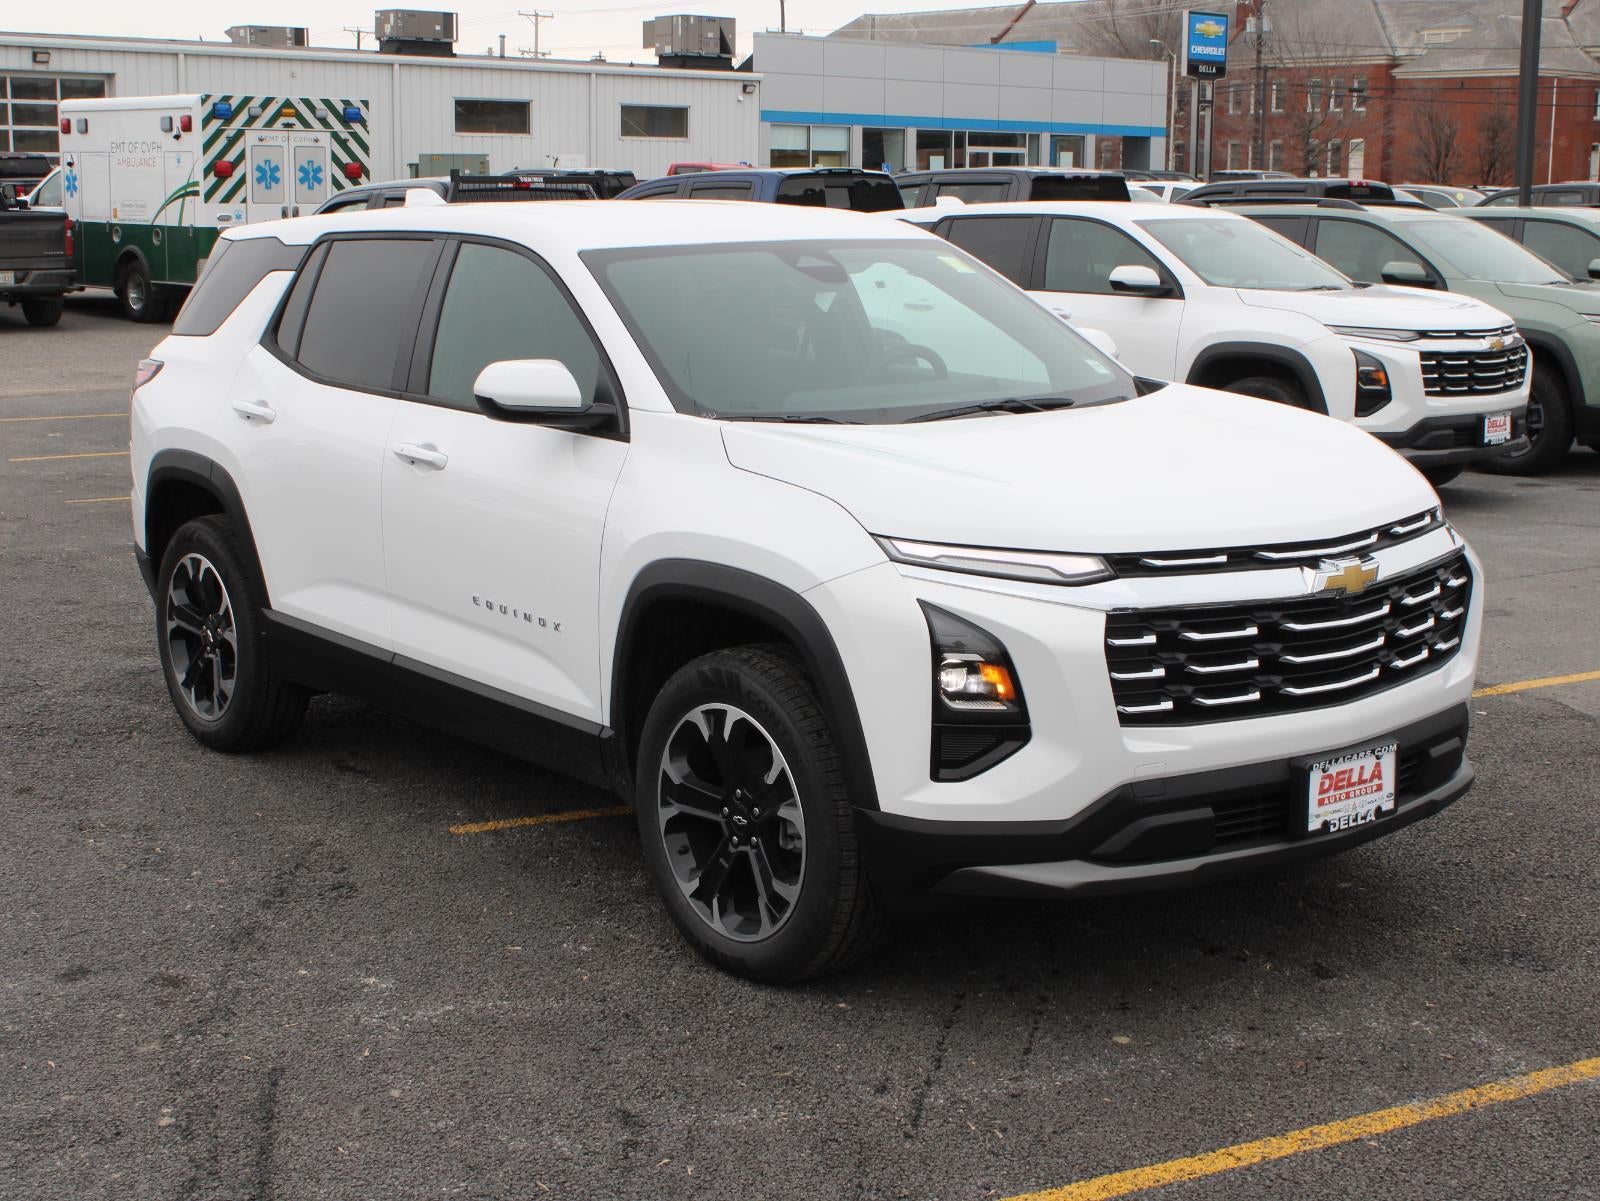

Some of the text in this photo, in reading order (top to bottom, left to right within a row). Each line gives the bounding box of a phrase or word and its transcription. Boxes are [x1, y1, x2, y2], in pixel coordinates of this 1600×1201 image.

[1191, 45, 1225, 56] CHEVROLET
[1199, 65, 1216, 73] DELLA
[111, 141, 161, 153] EMT OF CVPH
[117, 157, 157, 168] AMBULANCE
[472, 595, 561, 632] EQUINOX
[1318, 761, 1382, 795] DELLA
[1323, 785, 1377, 805] AUTO GROUP
[1329, 809, 1375, 833] DELLA
